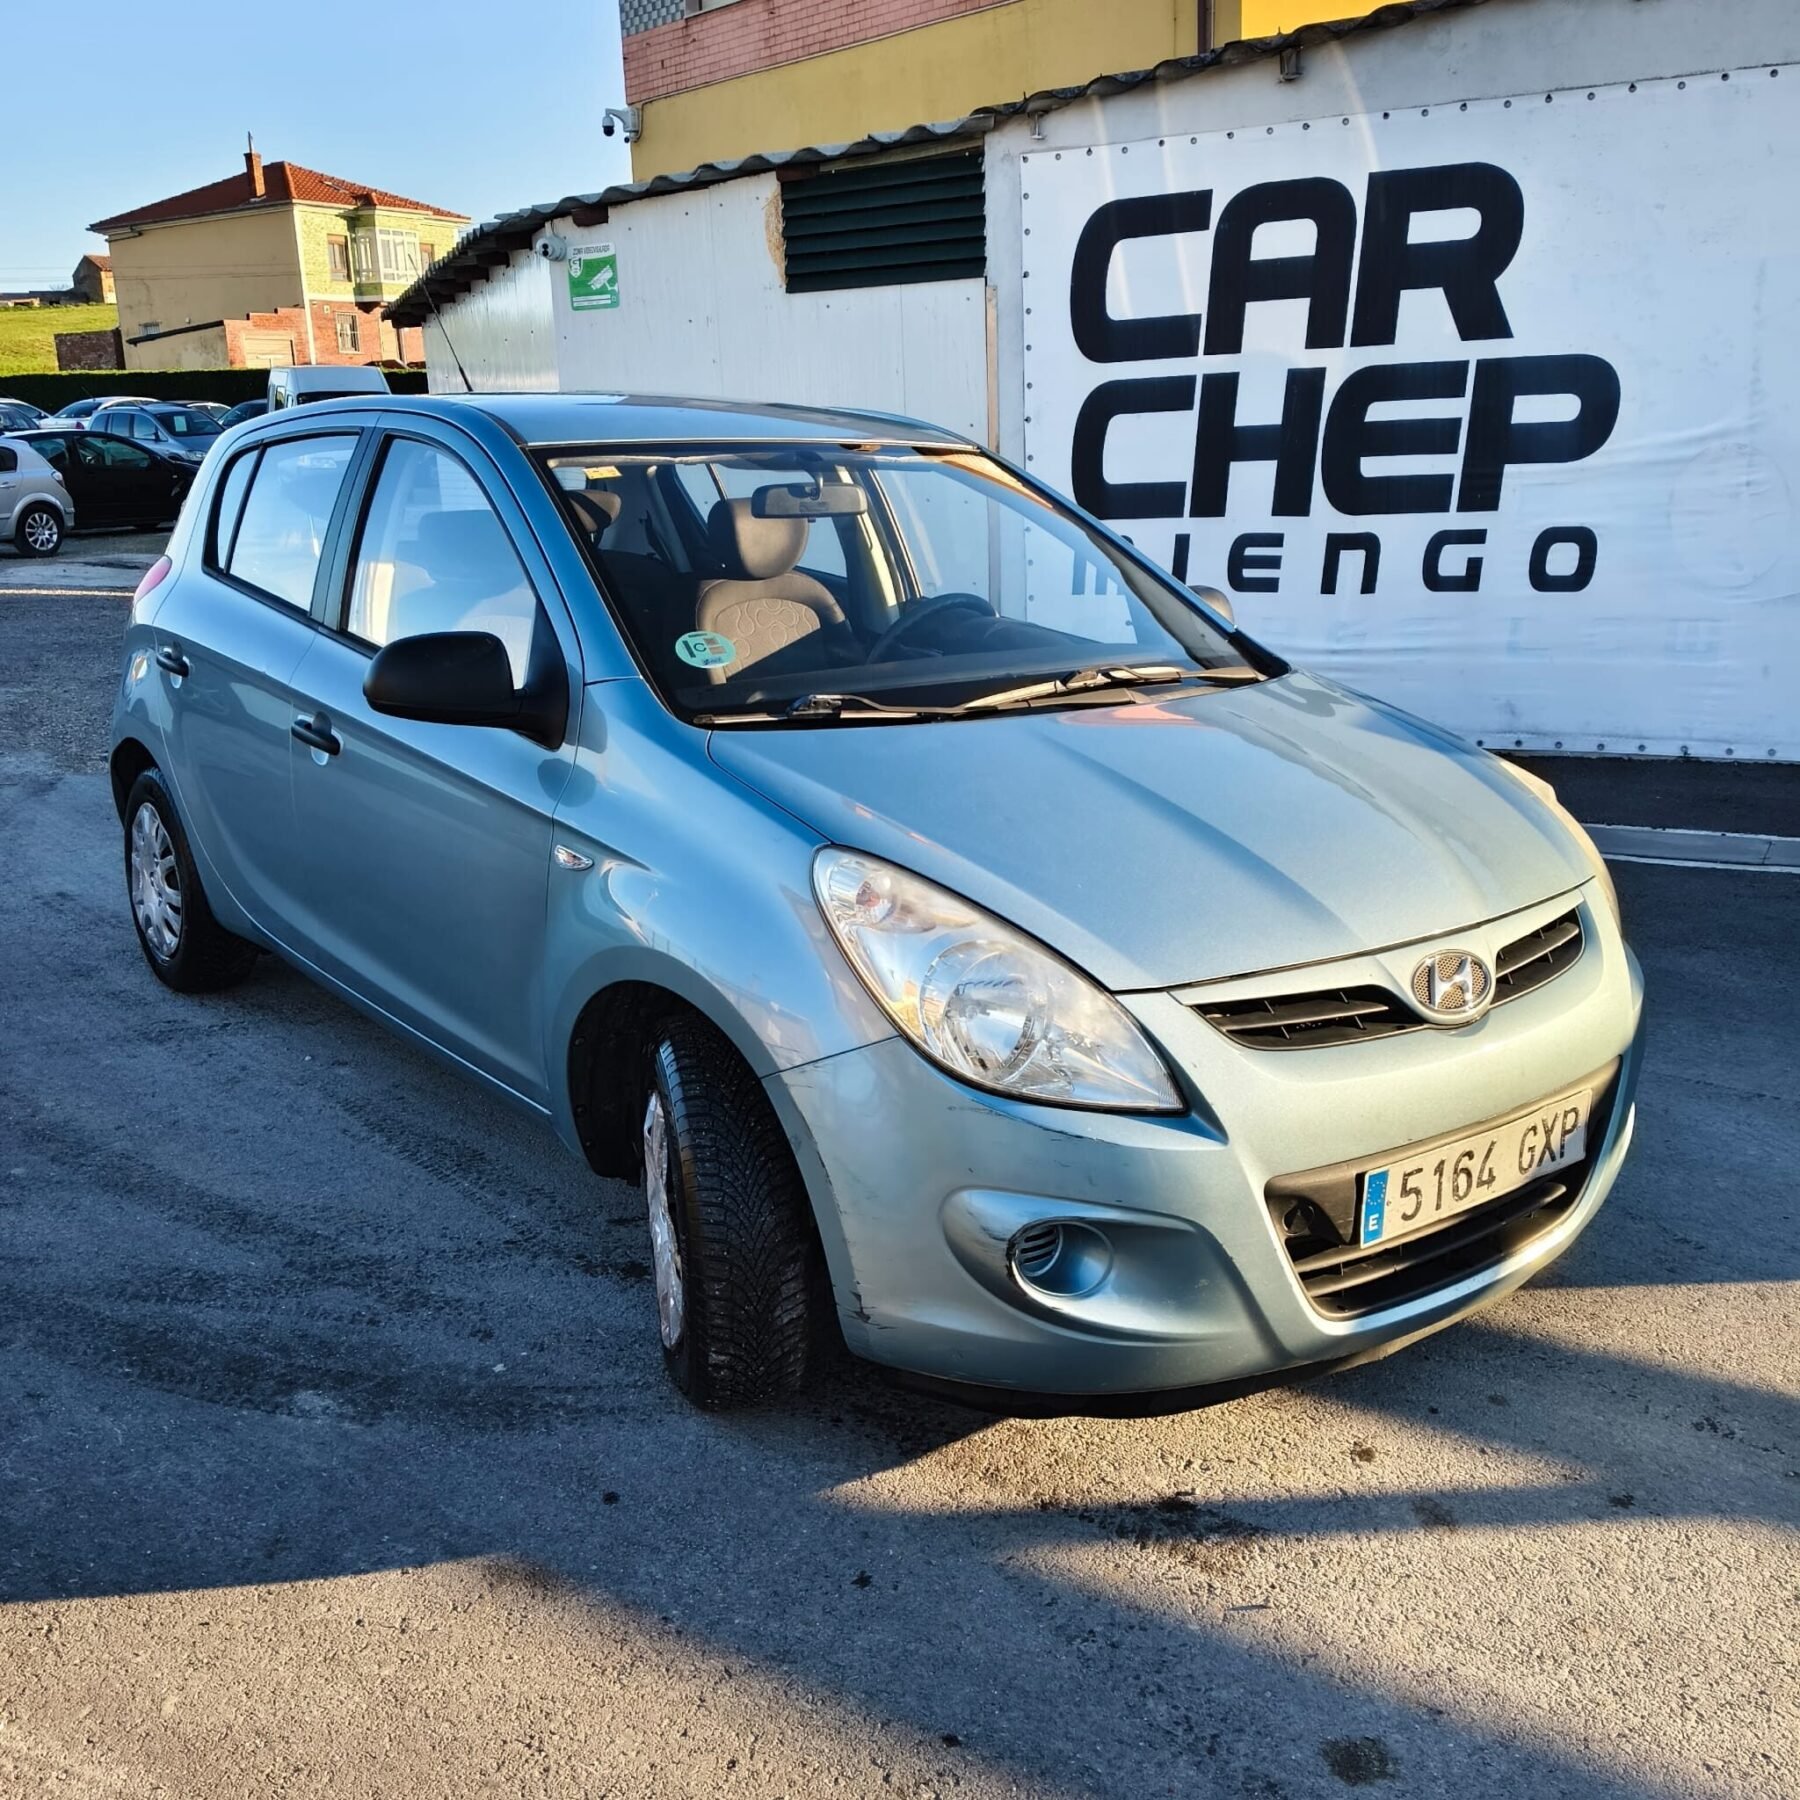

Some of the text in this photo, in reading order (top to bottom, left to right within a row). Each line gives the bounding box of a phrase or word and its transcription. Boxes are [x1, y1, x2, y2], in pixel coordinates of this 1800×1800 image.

[1070, 161, 1524, 363] CAR
[1071, 353, 1621, 520] CHEP
[1368, 1213, 1379, 1231] E
[1400, 1106, 1580, 1221] 5164 GXP
